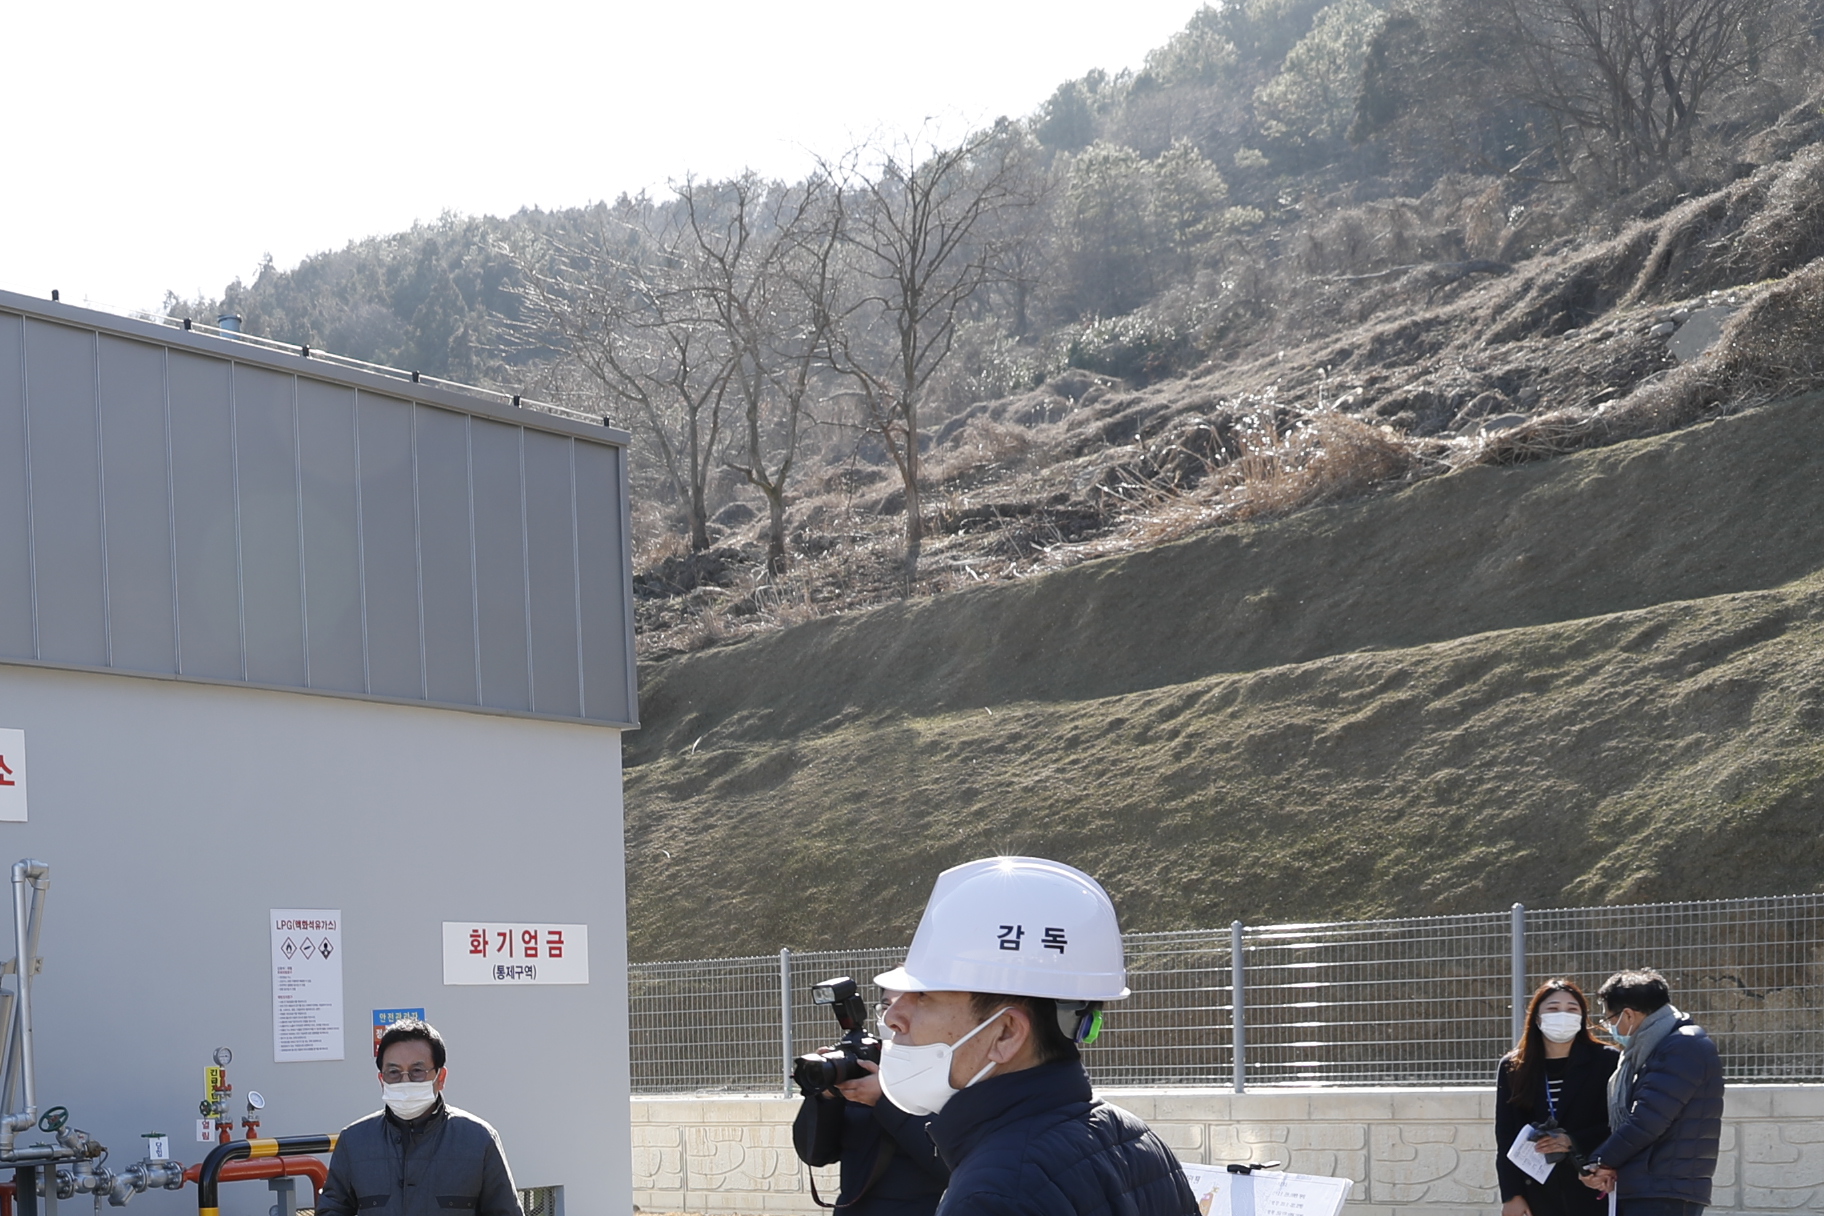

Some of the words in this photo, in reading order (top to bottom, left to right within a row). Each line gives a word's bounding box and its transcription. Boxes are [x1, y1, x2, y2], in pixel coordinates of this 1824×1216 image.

[276, 920, 337, 931] LPG(액화석유가스)
[469, 928, 565, 958] 화기엄금
[996, 924, 1068, 955] 감독
[492, 964, 537, 980] (통제구역)
